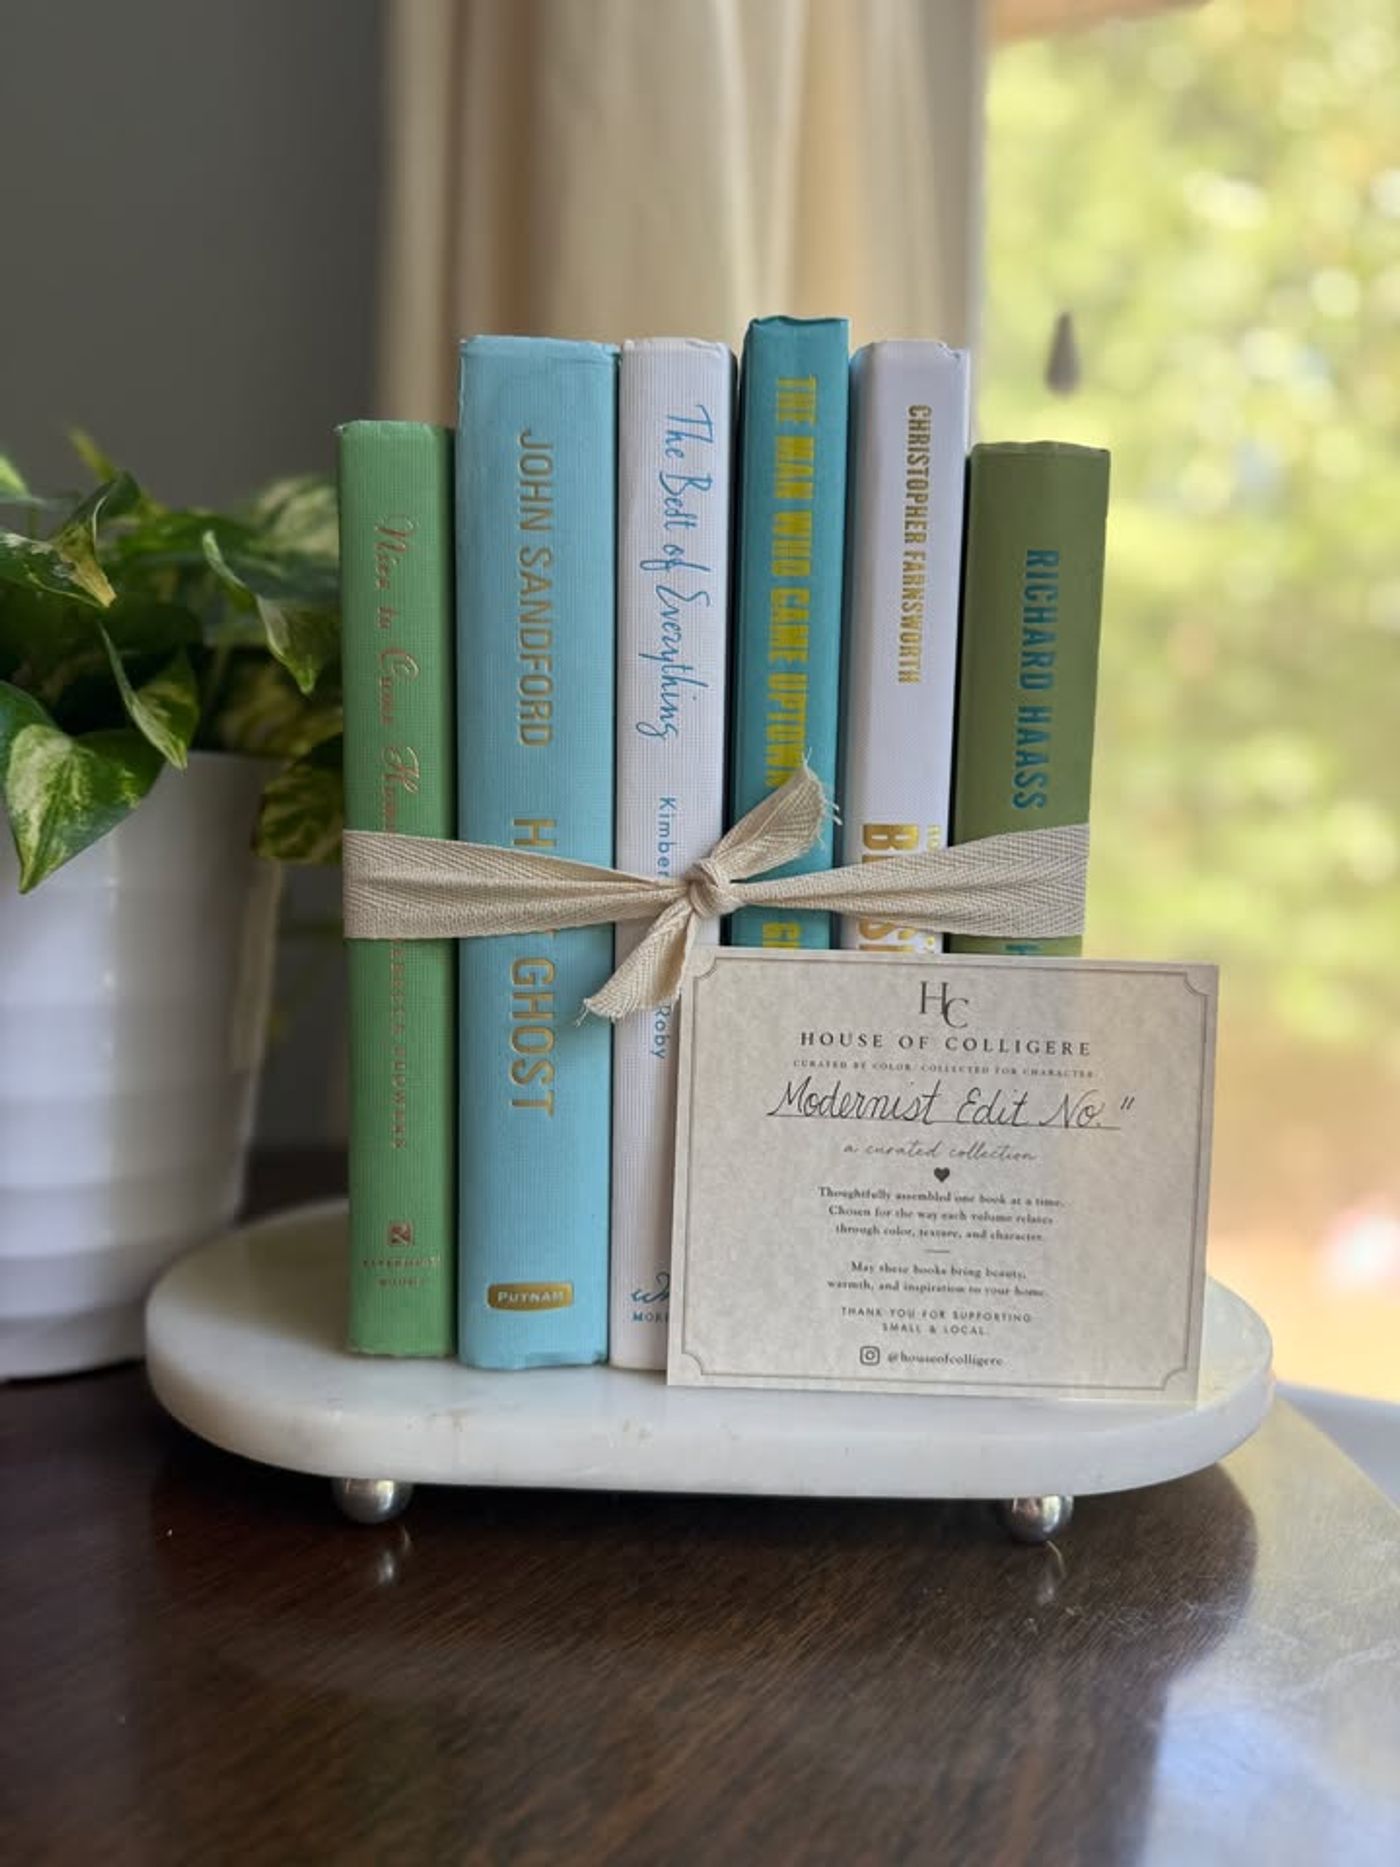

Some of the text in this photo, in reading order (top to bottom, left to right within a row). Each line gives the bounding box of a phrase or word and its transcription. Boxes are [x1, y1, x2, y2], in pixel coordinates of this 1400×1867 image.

[775, 377, 817, 426] THE
[774, 436, 815, 500] MAN
[771, 511, 813, 577] WHO
[898, 404, 932, 683] CHRISTOPHER FARNSWORTH
[636, 404, 714, 741] The Best of Everything
[517, 427, 555, 747] JOHN SANDFORD
[377, 605, 398, 630] to
[769, 586, 810, 664] CAME
[1012, 549, 1060, 810] RICHARD HAASS
[509, 956, 556, 1117] GHOST
[799, 1031, 1092, 1057] HOUSE OF COLLIGERE
[792, 1059, 847, 1070] CURATED
[853, 1061, 867, 1071] BY
[921, 1064, 990, 1076] COLLECTED
[994, 1066, 1018, 1076] FOR
[767, 1077, 942, 1125] Modernist
[955, 1087, 1031, 1127] Edit
[865, 1141, 942, 1158] curated
[948, 1143, 1037, 1162] collection
[818, 1186, 891, 1200] Thoughtfully
[895, 1189, 951, 1202] assembled
[954, 1195, 975, 1203] one
[979, 1193, 1006, 1205] book
[828, 1204, 1053, 1225] Chosen for the way each volume relates
[835, 1221, 880, 1237] through
[883, 1225, 916, 1237] color,
[966, 1229, 987, 1239] and
[851, 1261, 875, 1274] May
[879, 1262, 909, 1275] these
[913, 1264, 947, 1276] books
[951, 1266, 982, 1279] bring
[497, 1288, 566, 1304] PUTNAM
[827, 1279, 875, 1292] warmth,
[879, 1280, 900, 1292] and
[904, 1281, 966, 1295] inspiration
[968, 1285, 982, 1294] to
[985, 1286, 1011, 1297] your
[841, 1307, 1033, 1324] THANK YOU FOR SUPPORTING
[882, 1322, 922, 1334] SMALL
[887, 1353, 1003, 1368] @houseofcolligere
